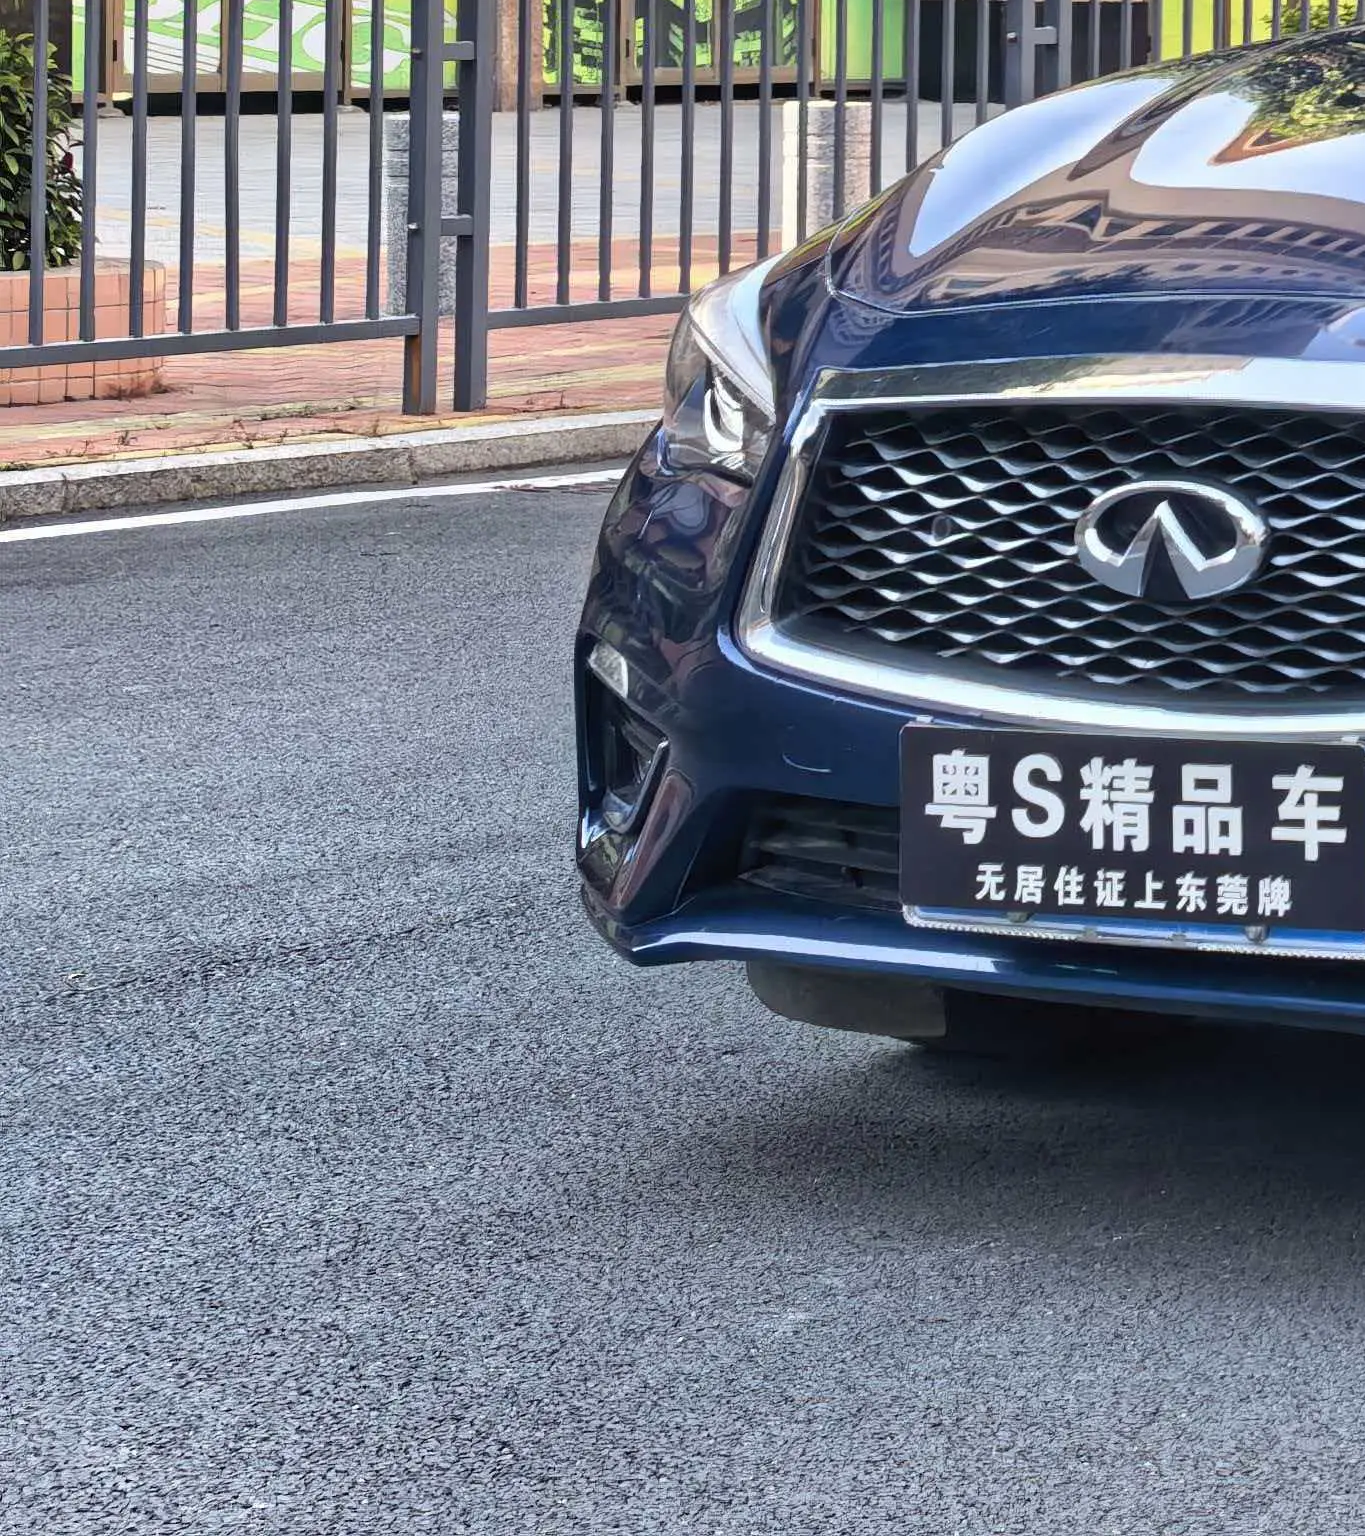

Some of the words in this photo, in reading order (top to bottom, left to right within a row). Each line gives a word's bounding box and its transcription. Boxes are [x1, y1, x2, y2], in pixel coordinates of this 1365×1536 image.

[924, 748, 1347, 862] 粤S精品车
[975, 861, 1293, 918] 无居住证上东莞牌
